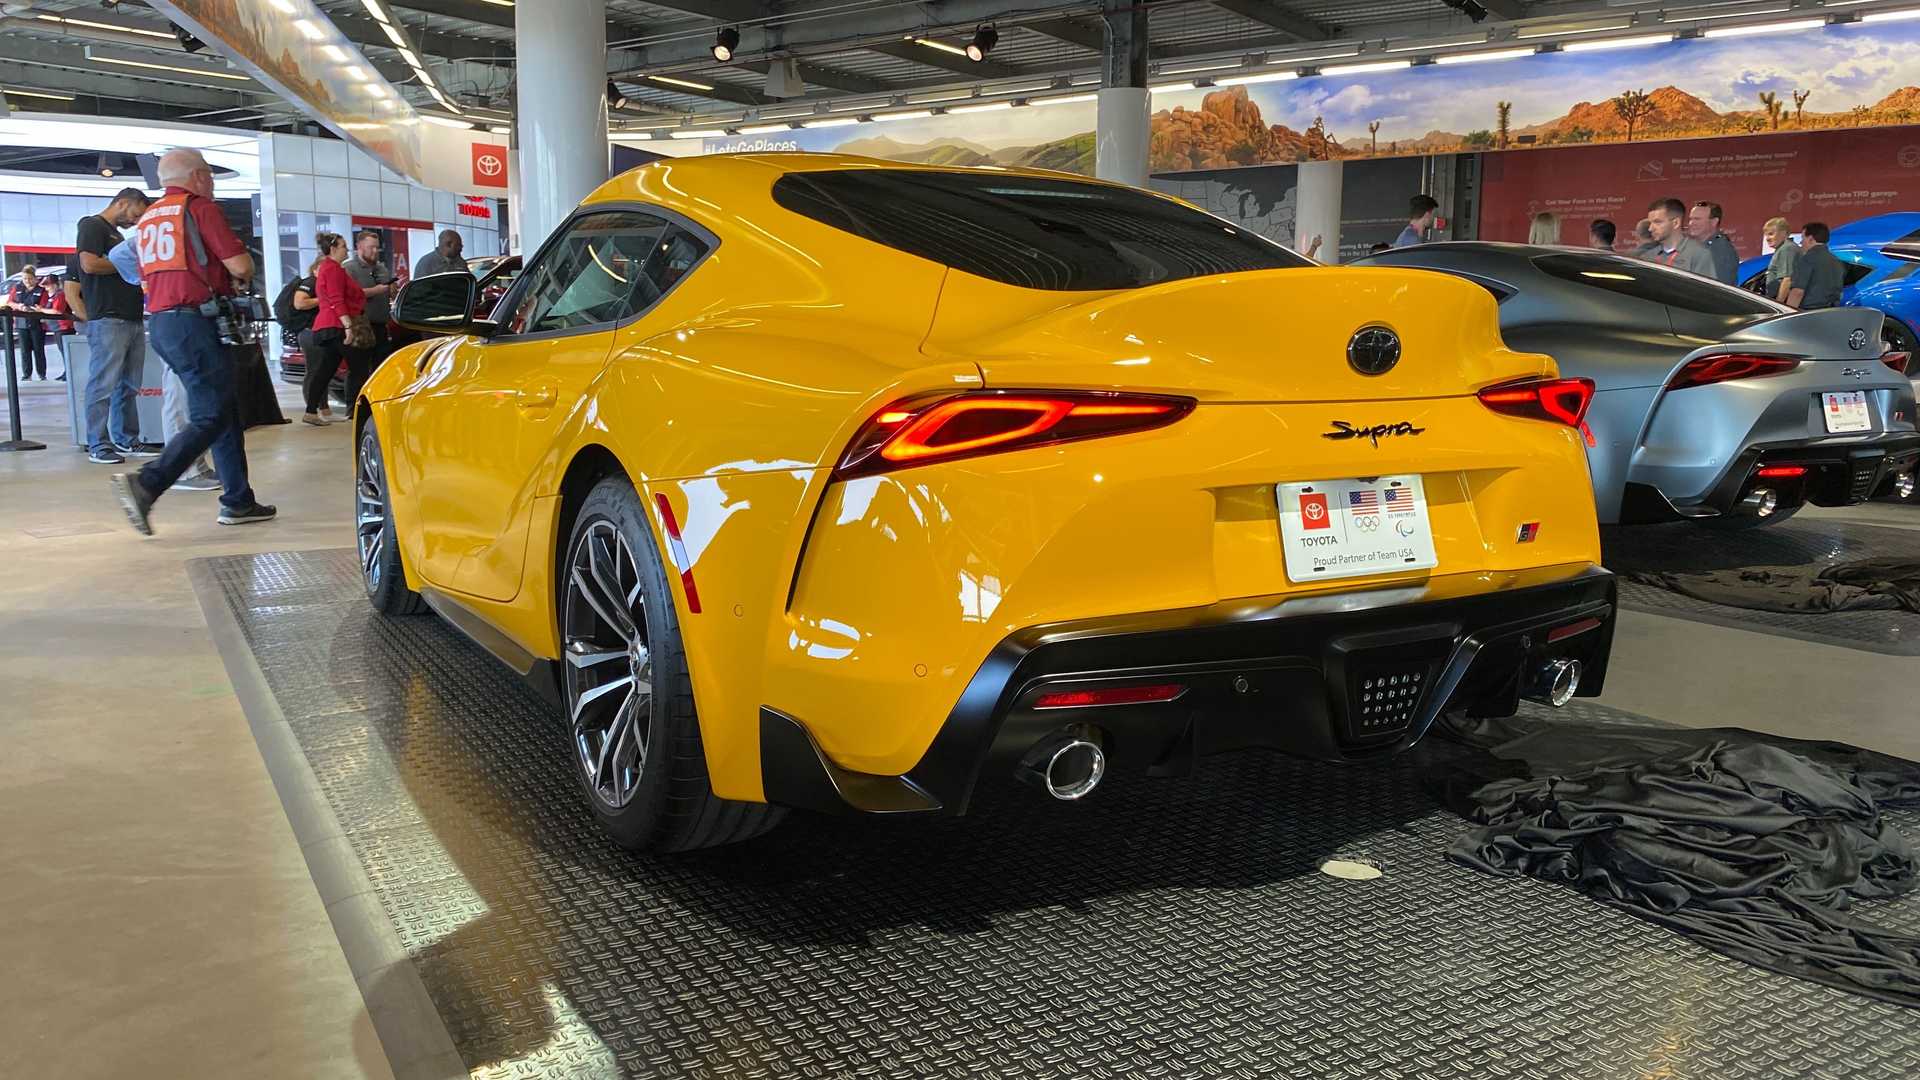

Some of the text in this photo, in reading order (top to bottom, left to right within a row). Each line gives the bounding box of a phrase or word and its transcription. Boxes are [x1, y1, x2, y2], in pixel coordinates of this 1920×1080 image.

[1321, 420, 1425, 449] Supra
[1301, 535, 1338, 548] TOYOTA
[1313, 548, 1414, 567] Proud Partner of Team USA
